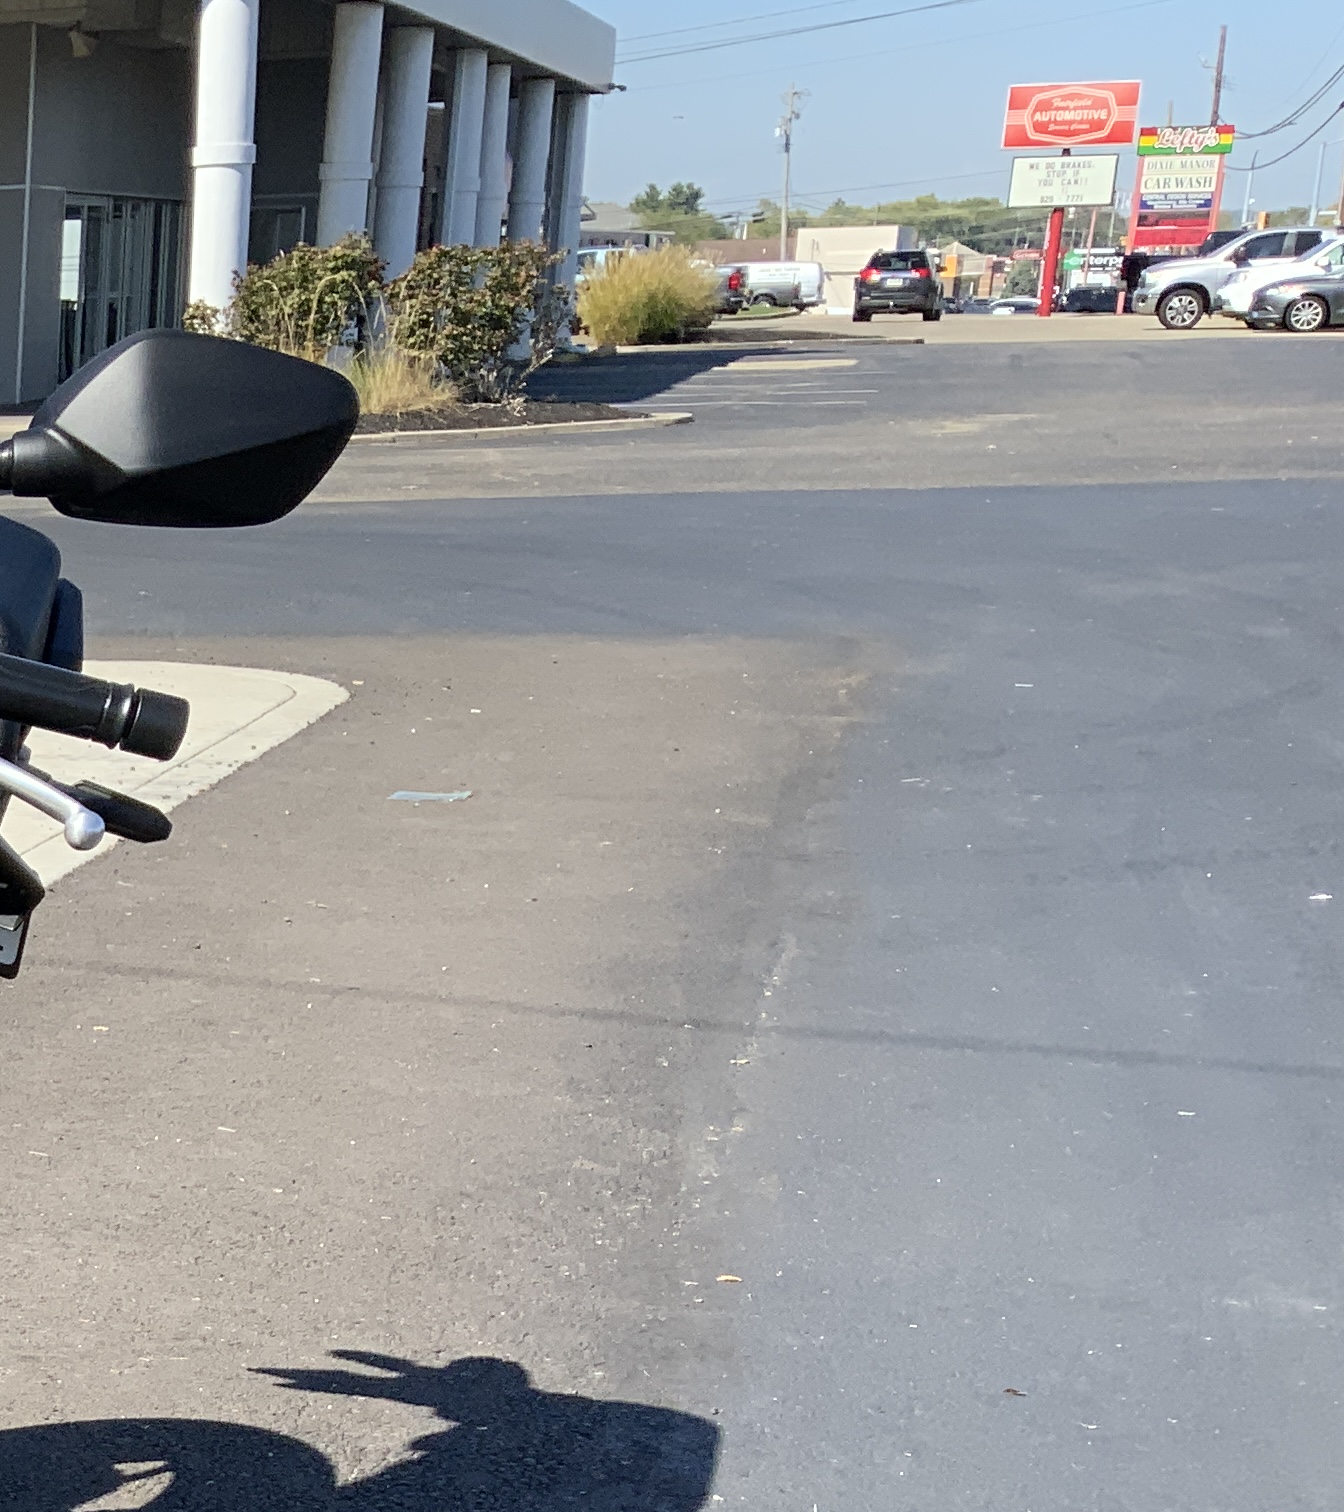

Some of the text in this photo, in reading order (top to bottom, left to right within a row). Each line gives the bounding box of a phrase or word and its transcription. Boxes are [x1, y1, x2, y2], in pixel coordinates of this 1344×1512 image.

[1033, 108, 1108, 122] AUTOMOTIVE
[1153, 127, 1220, 153] Lefty's
[1147, 159, 1216, 170] DIXIE MANOR
[1046, 169, 1067, 178] STOP
[1038, 178, 1054, 186] YOU
[1144, 176, 1213, 190] CAR WASH
